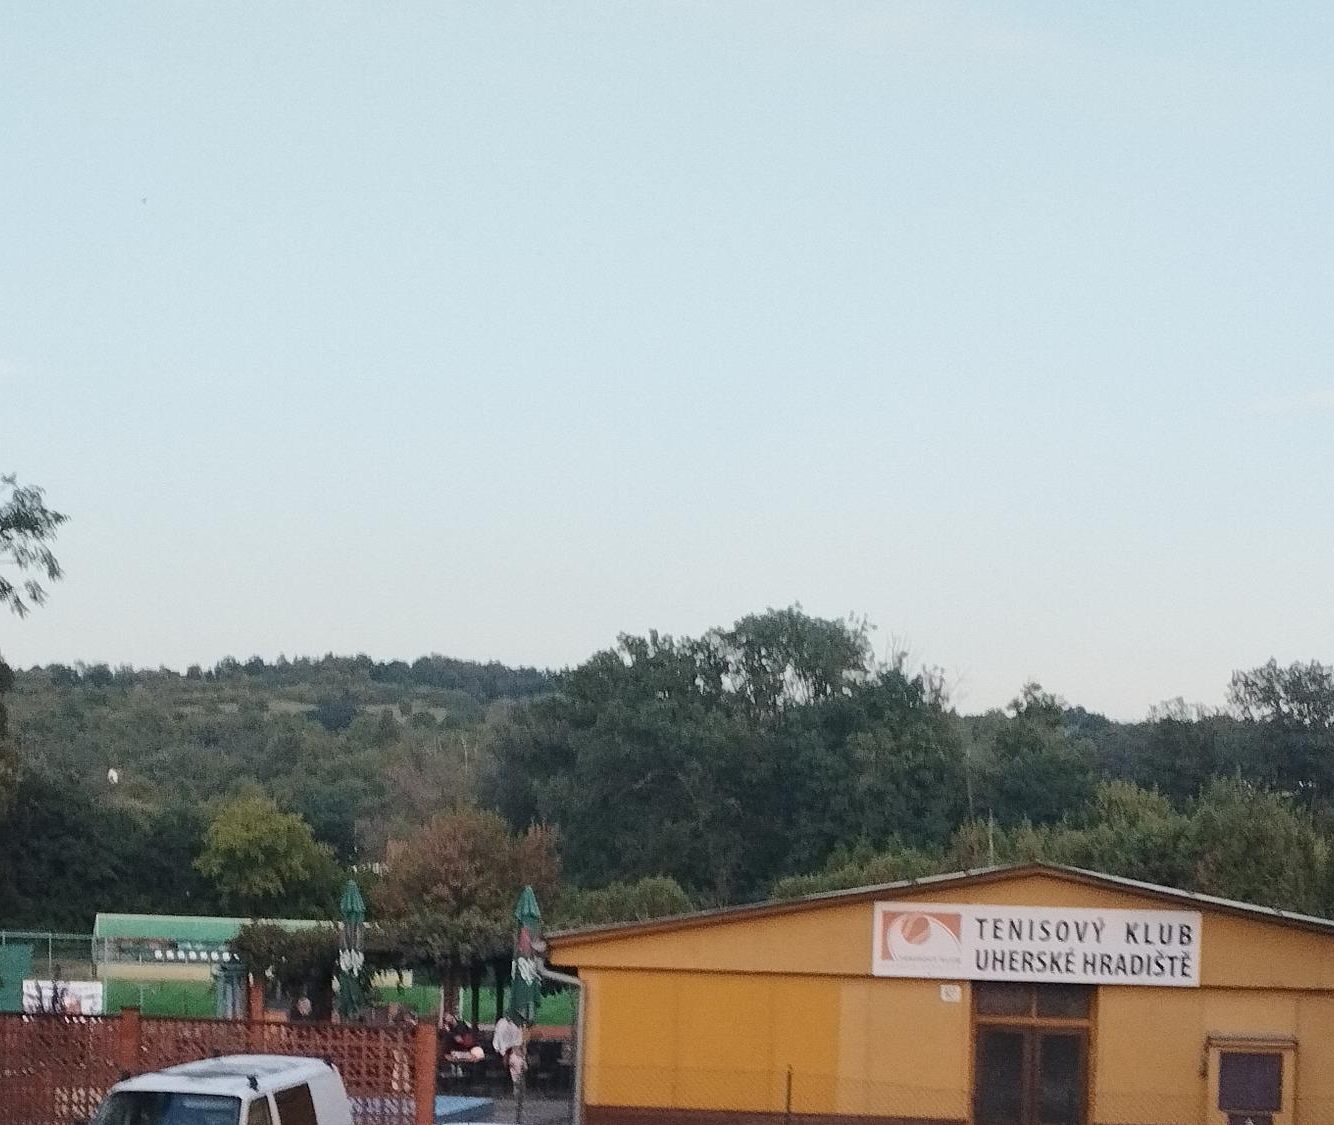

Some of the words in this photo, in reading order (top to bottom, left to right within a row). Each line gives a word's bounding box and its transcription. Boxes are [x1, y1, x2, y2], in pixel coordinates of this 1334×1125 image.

[975, 916, 1106, 944] TENISOVÝ
[1125, 921, 1193, 946] KLUB
[975, 946, 1077, 975] UHERSKÉ
[1082, 948, 1193, 978] HRADIŠTĚ
